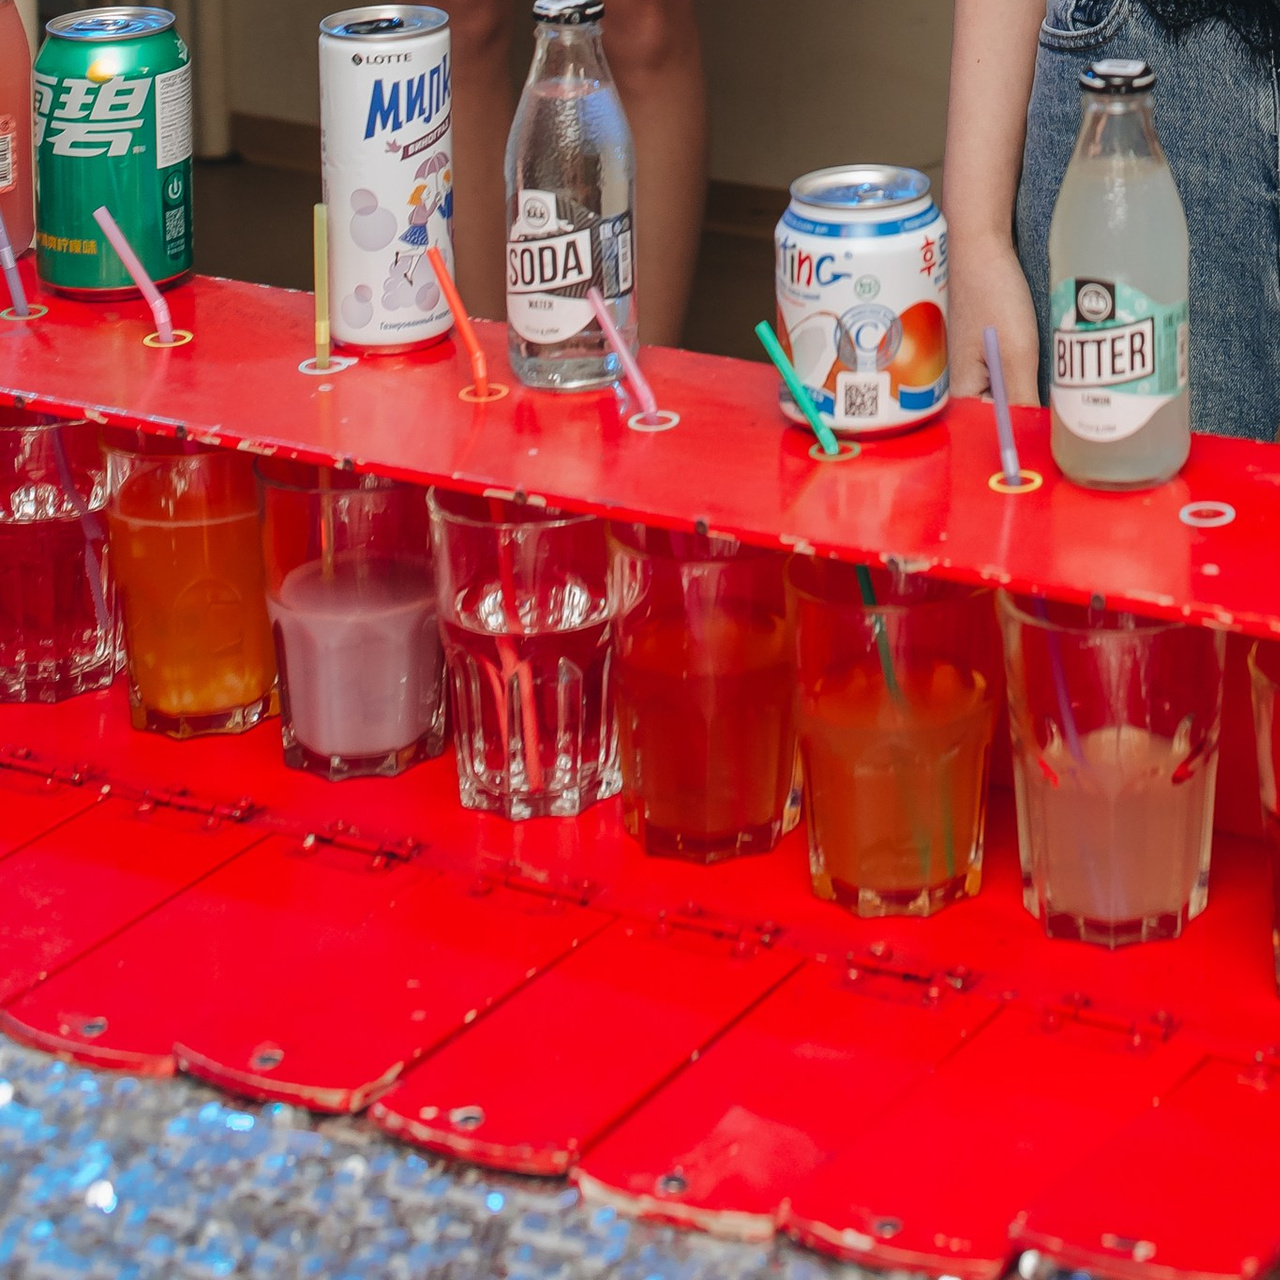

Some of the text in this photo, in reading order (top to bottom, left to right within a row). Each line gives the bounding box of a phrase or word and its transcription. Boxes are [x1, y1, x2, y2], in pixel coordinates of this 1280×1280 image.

[366, 52, 413, 65] LOTTE
[509, 239, 584, 286] SODA
[1057, 331, 1146, 380] BITTER
